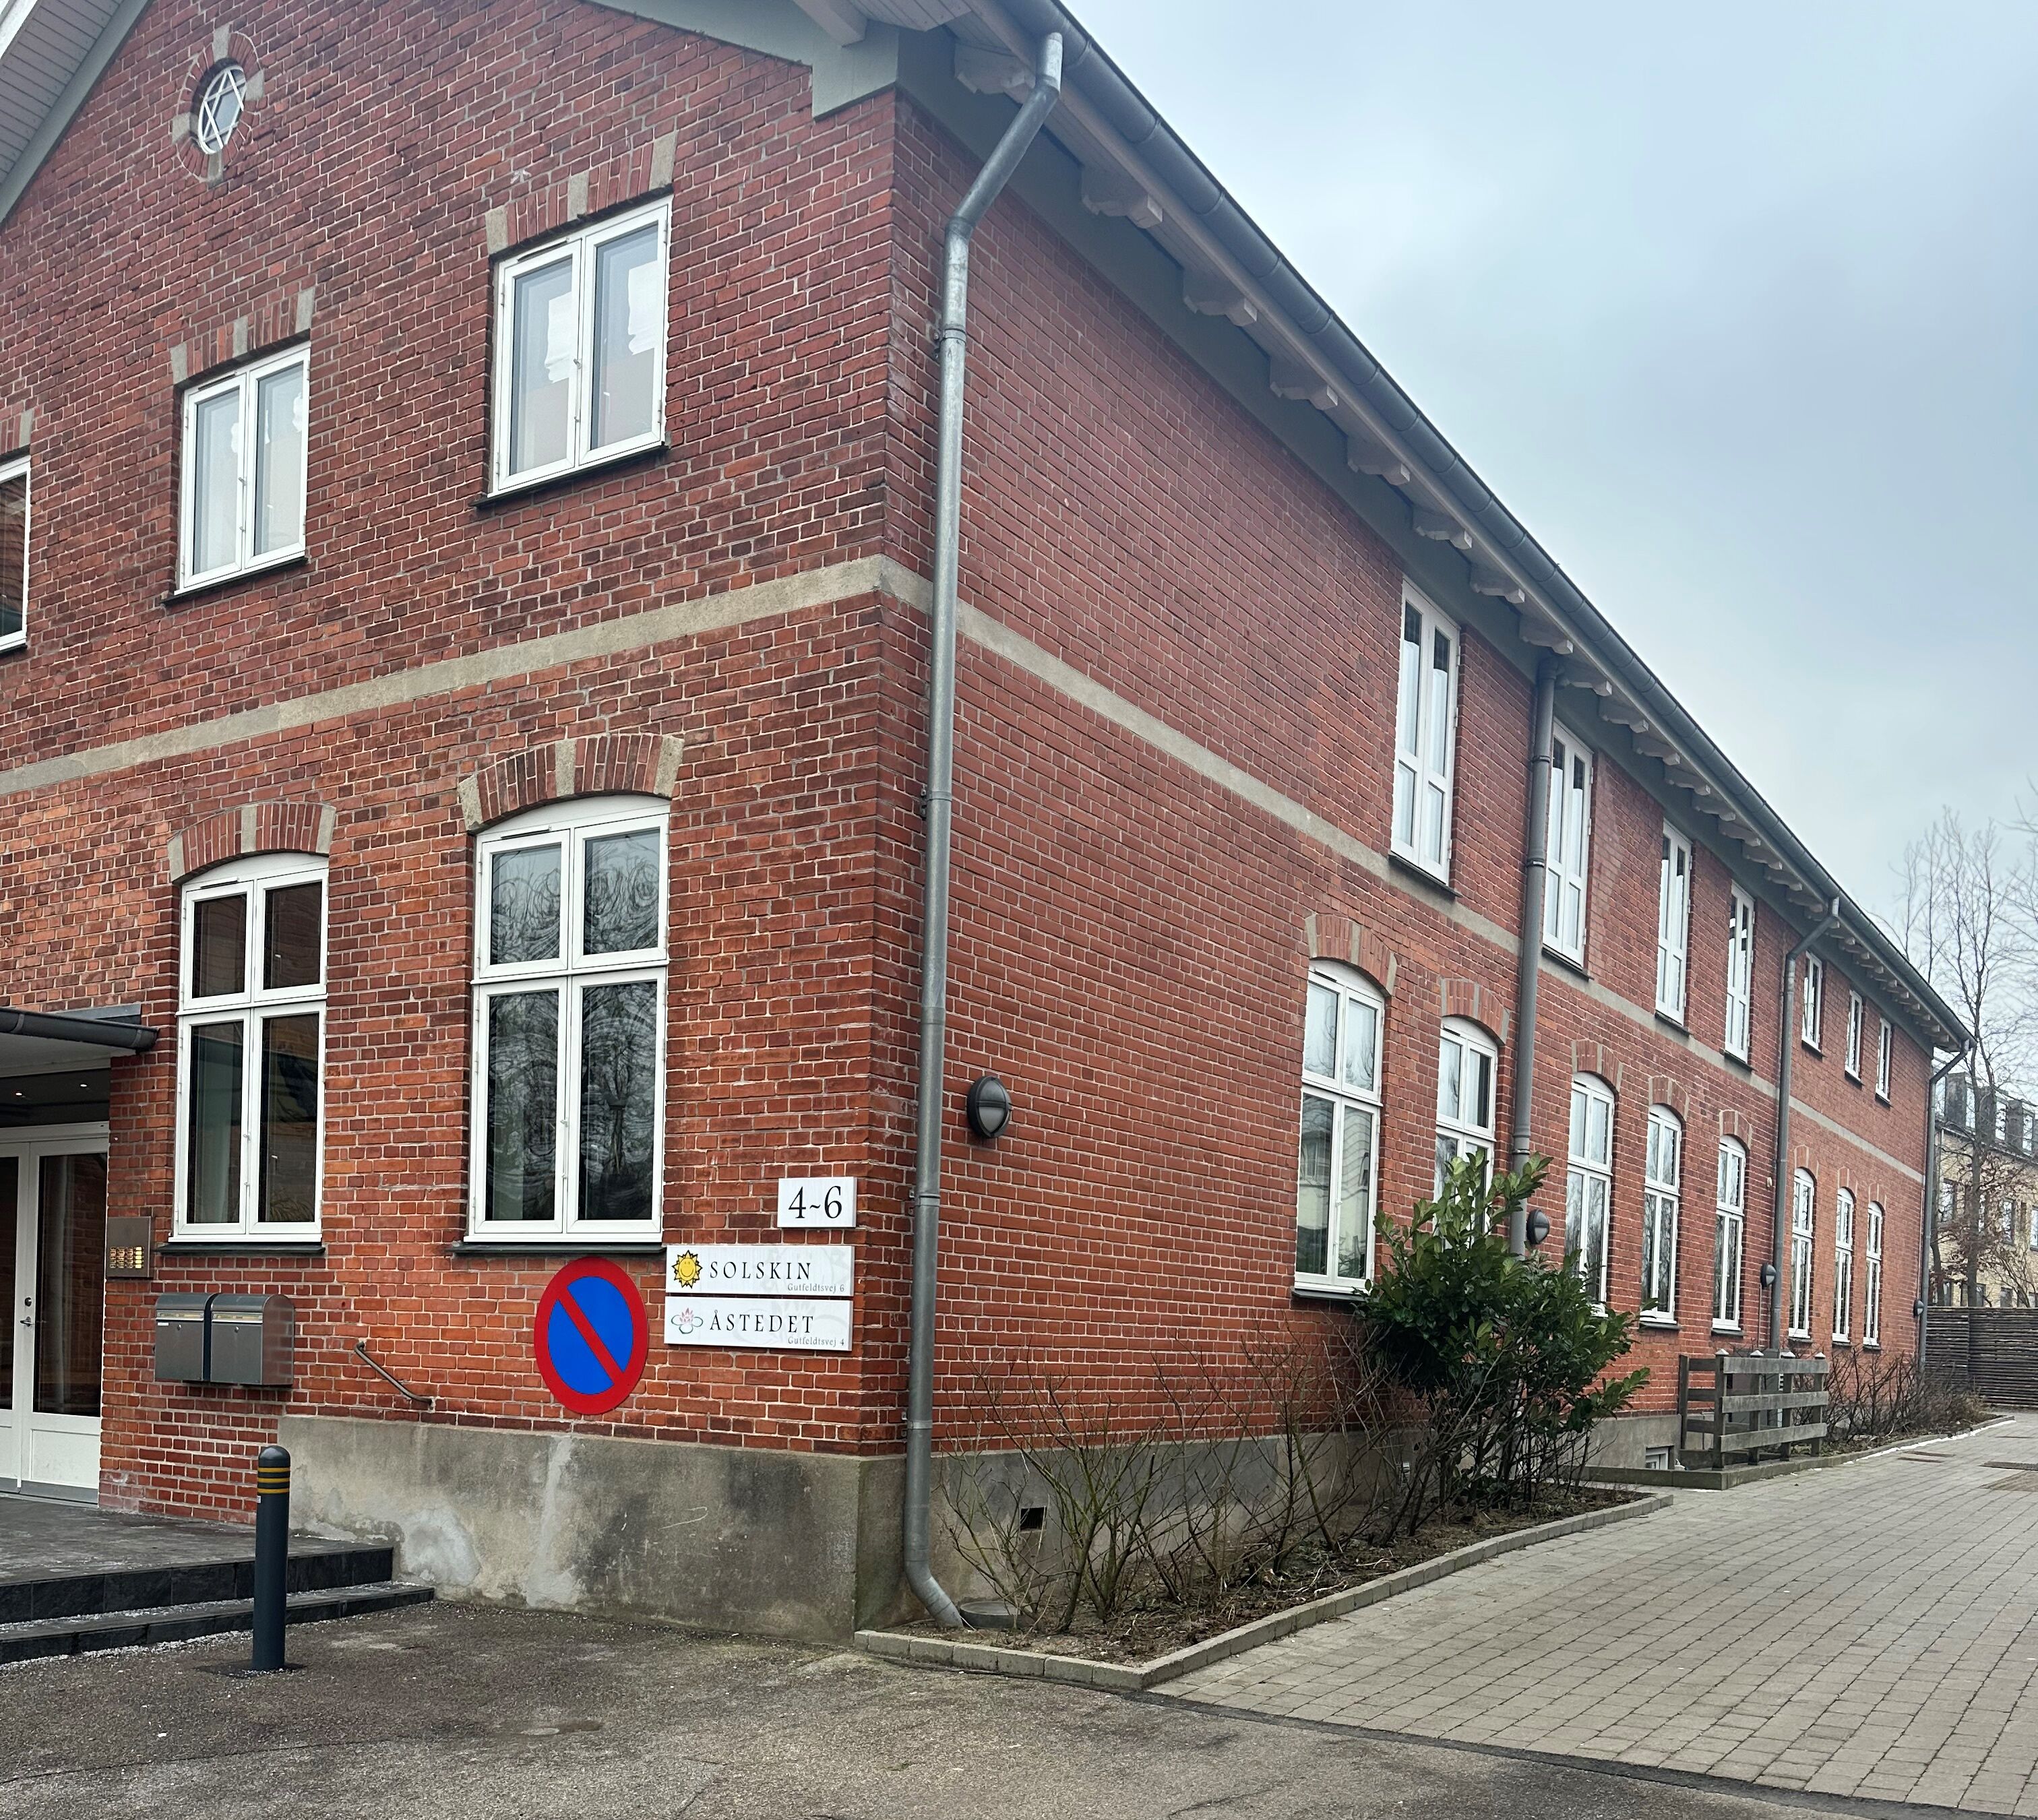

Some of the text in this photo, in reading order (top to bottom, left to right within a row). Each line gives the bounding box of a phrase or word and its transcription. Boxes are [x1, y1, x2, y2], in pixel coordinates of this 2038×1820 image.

[710, 1261, 811, 1280] SOLSKIN
[787, 1283, 844, 1294] Gutfeldtsvej 6
[710, 1309, 814, 1333] ÅSTEDET
[788, 1336, 844, 1348] Gutfeldtsvej 4
